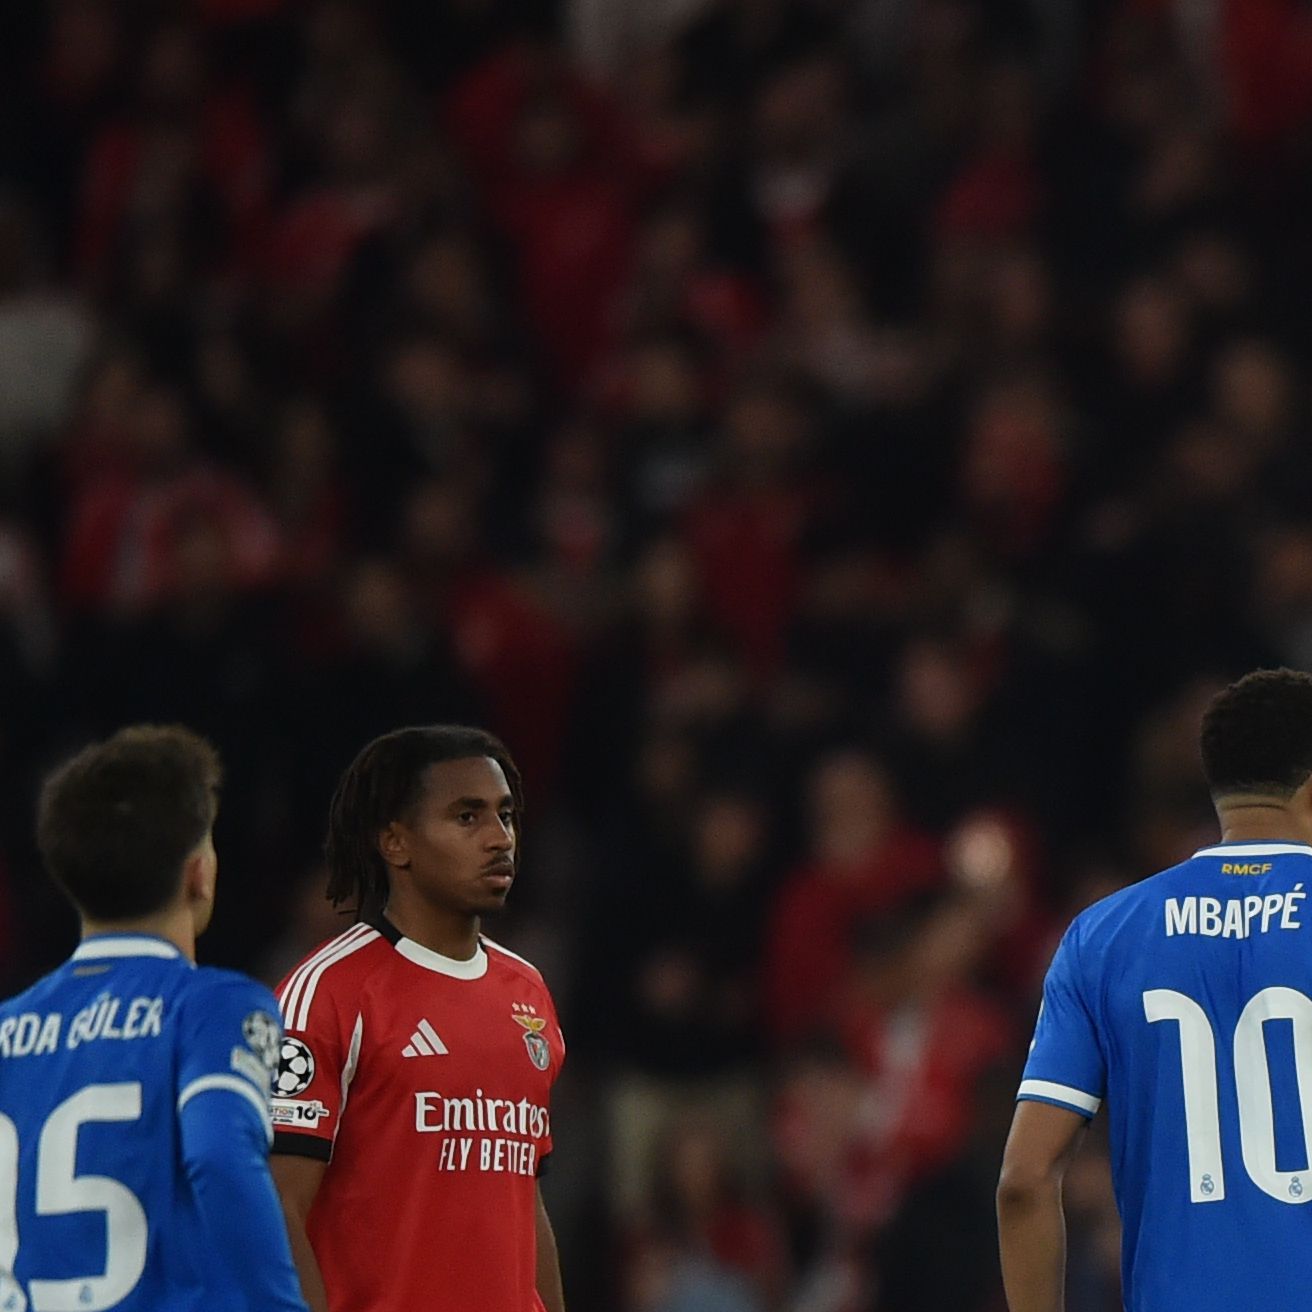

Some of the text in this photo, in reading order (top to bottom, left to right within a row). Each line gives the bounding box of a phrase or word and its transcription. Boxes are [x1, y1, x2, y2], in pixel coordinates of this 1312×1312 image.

[1164, 883, 1307, 940] MBAPPÉ
[414, 1088, 548, 1139] Emirates
[438, 1137, 536, 1177] FLY BETTER
